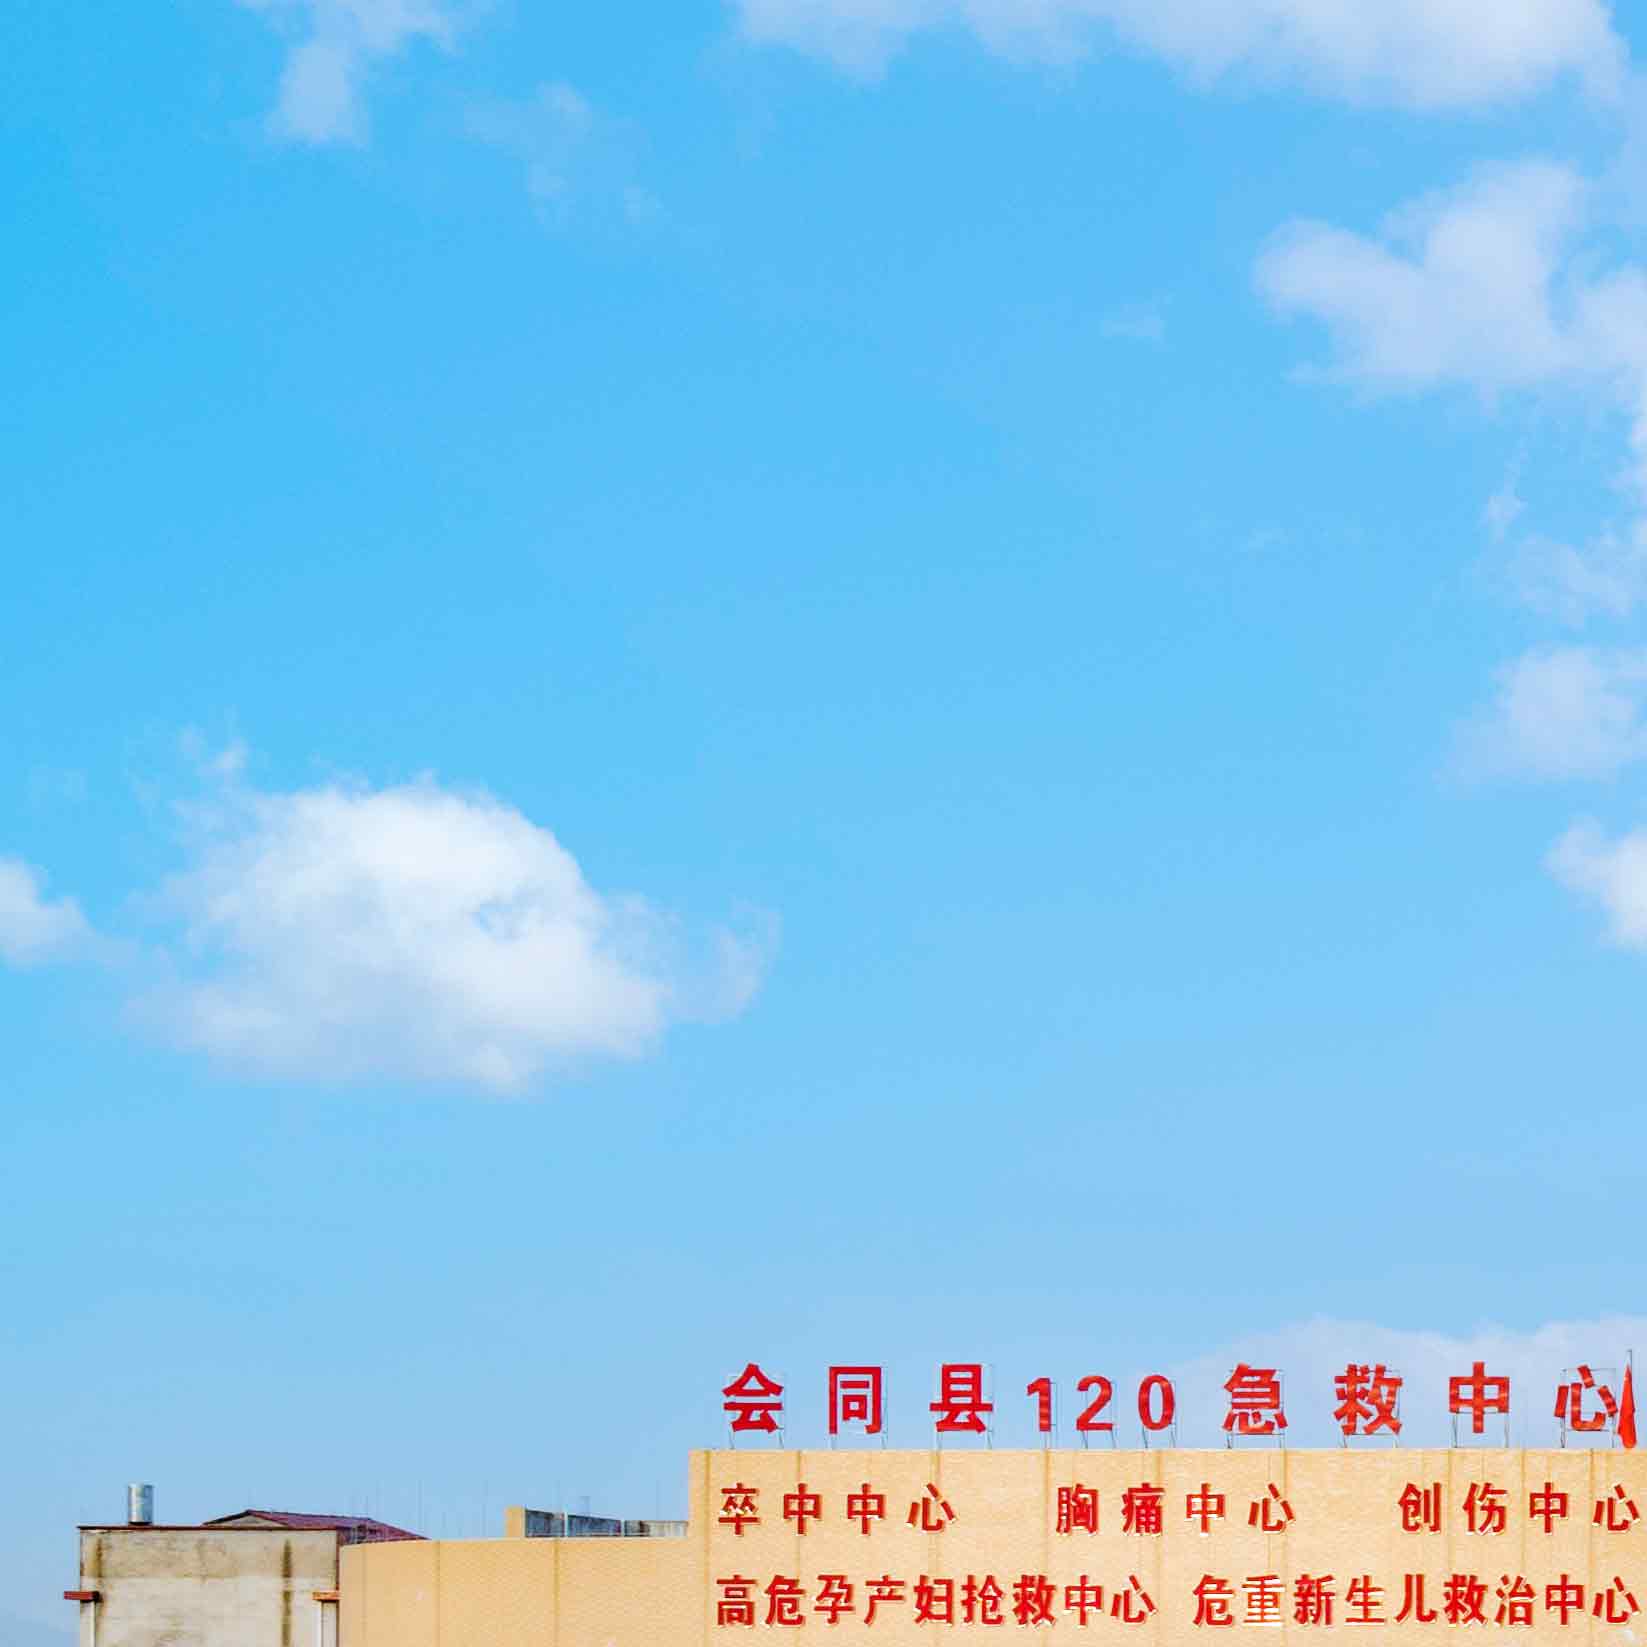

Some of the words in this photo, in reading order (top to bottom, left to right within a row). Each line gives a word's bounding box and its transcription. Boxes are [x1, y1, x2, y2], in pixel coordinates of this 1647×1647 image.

[720, 1361, 1618, 1437] 会同县120急救中心
[718, 1482, 958, 1537] 卒中中心
[1055, 1483, 1297, 1537] 胸痛中心
[1397, 1482, 1641, 1537] 创伤中心
[716, 1573, 1156, 1629] 高危孕产妇抢救中心
[1192, 1574, 1641, 1629] 危重新生儿救治中心
